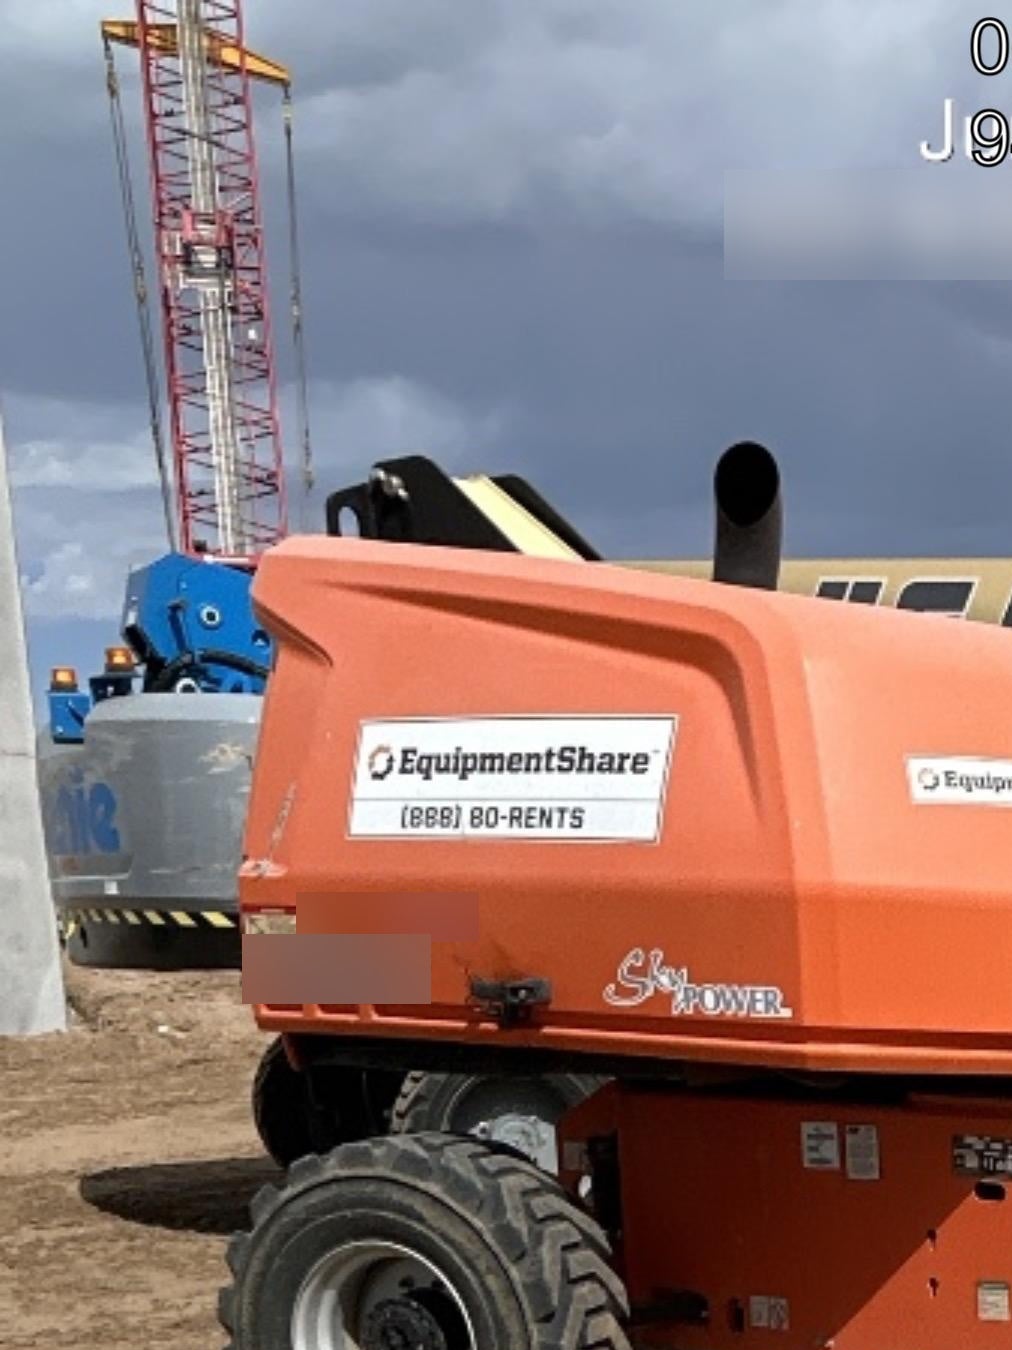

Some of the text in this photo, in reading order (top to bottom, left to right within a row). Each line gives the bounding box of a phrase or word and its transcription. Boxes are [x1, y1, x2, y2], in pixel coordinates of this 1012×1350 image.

[399, 746, 650, 781] EquipmentShare
[401, 804, 586, 829] (888) 80-RENTS
